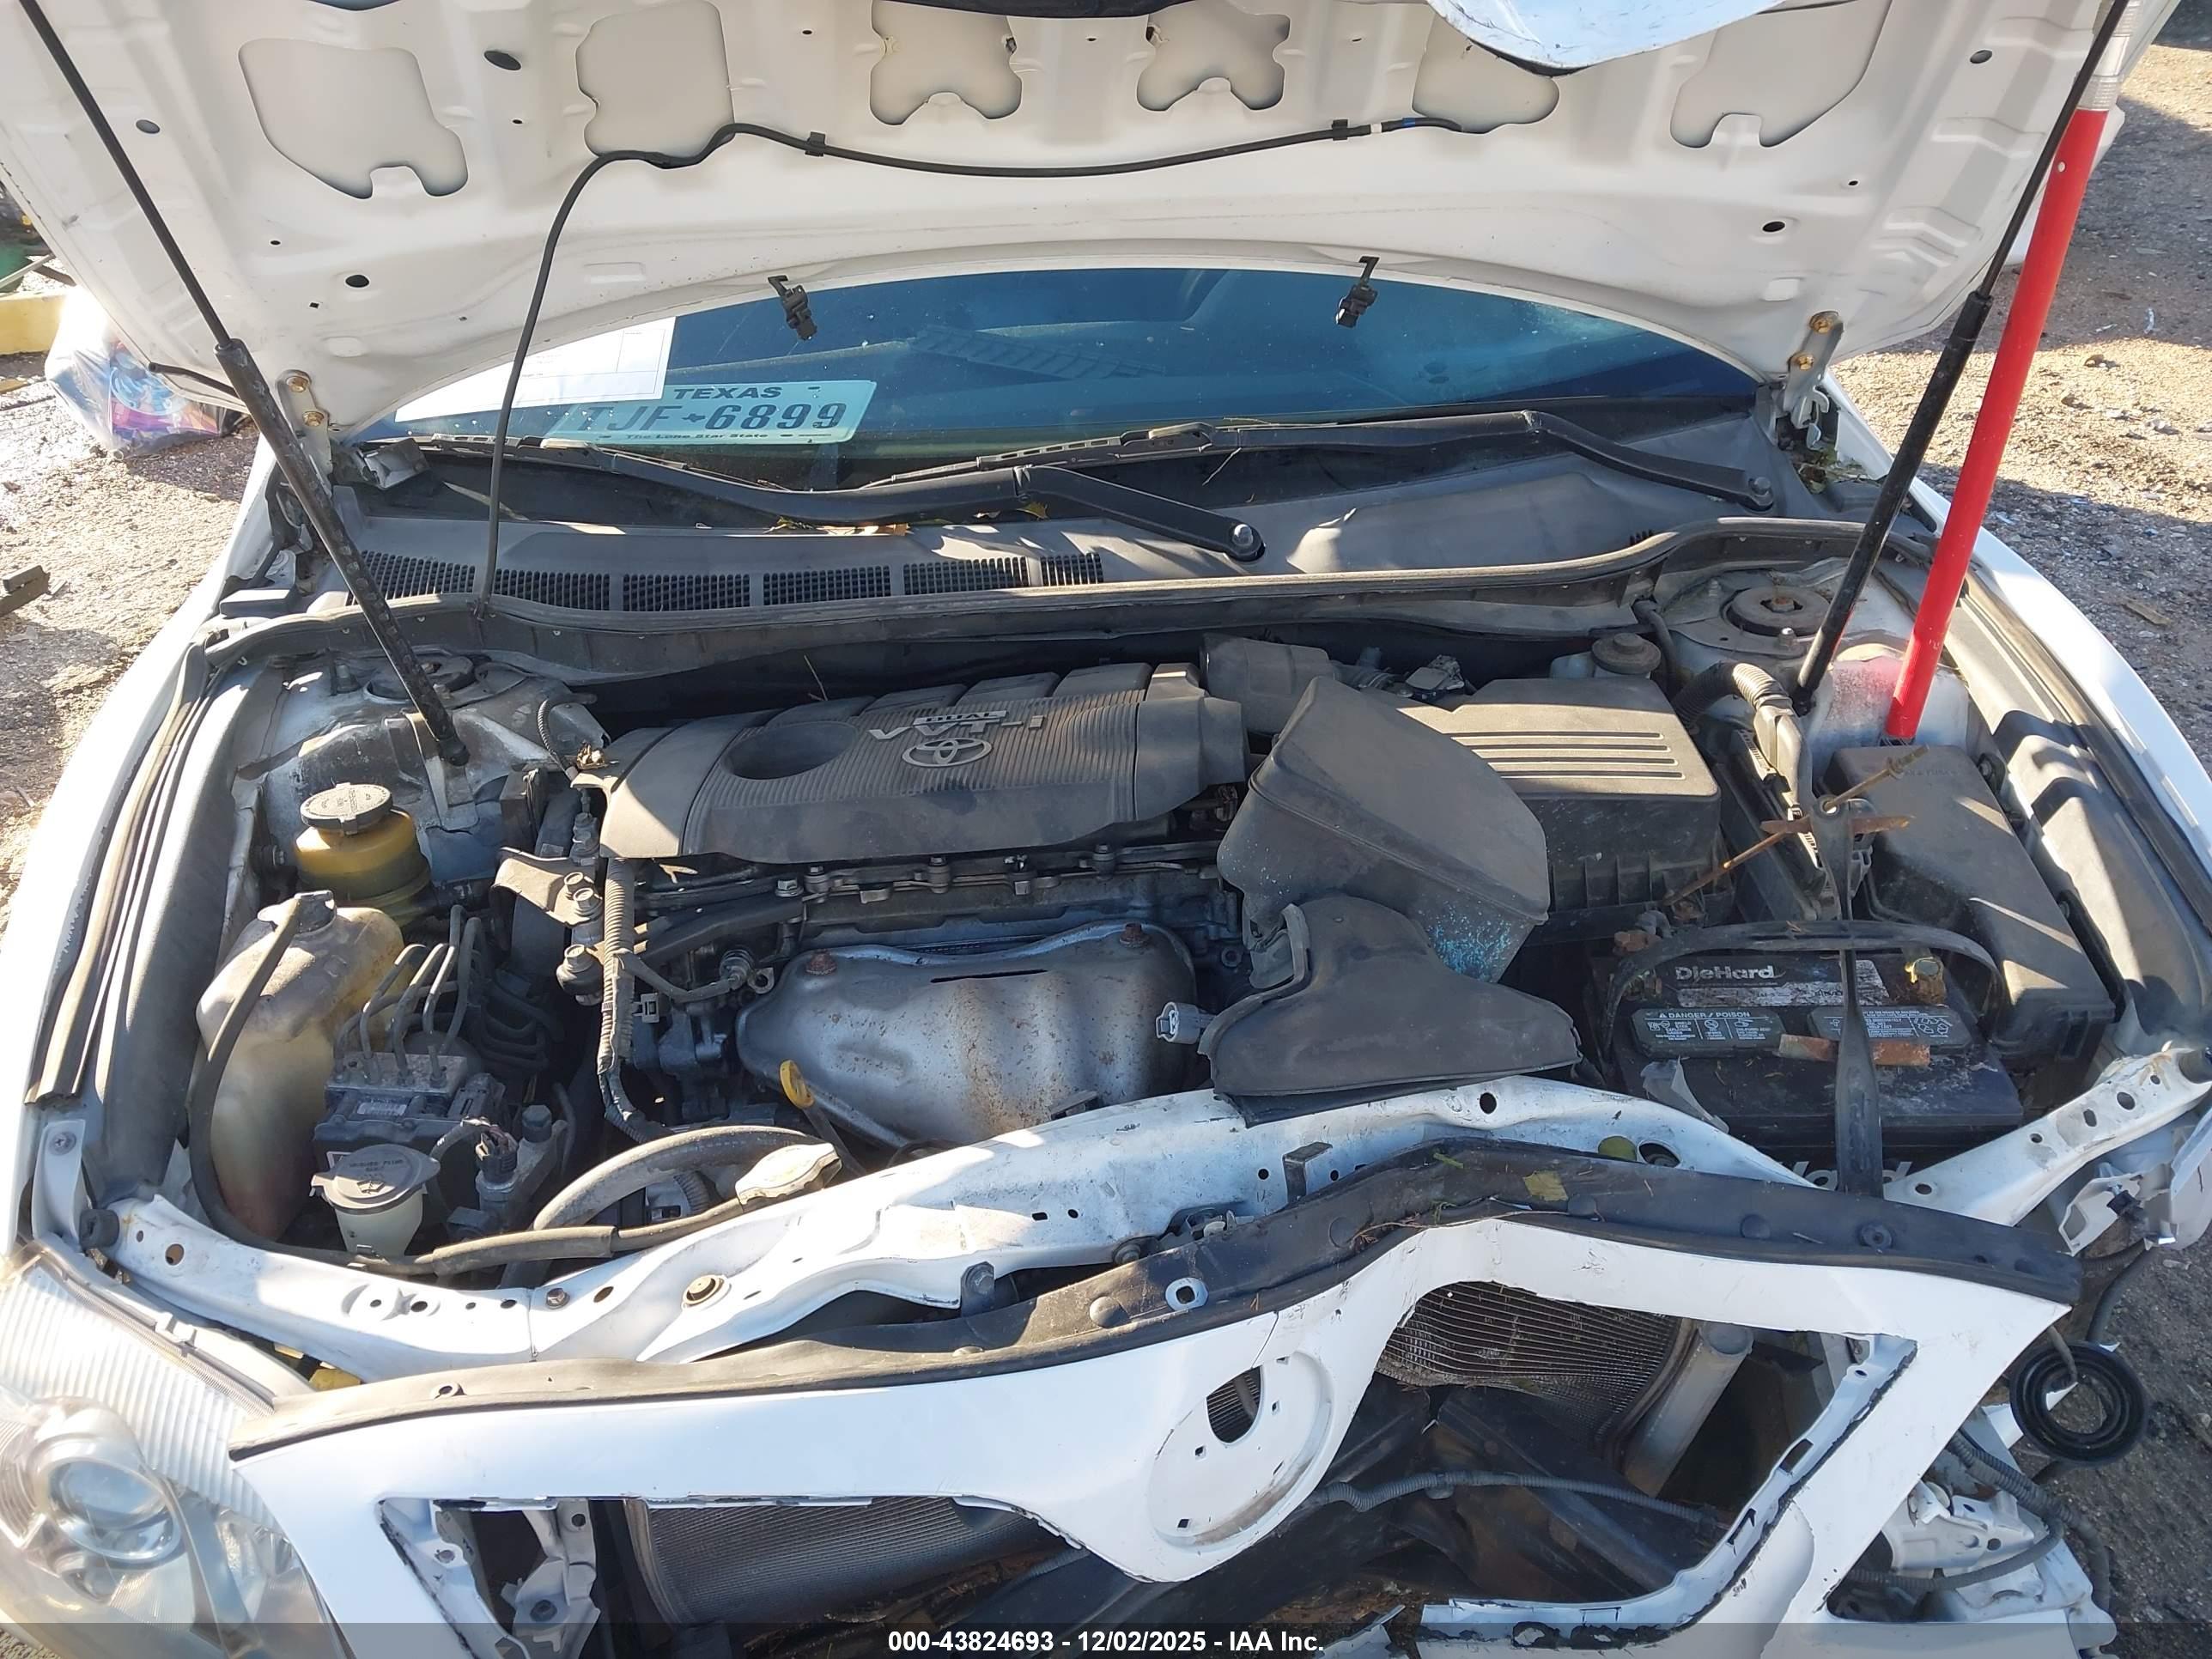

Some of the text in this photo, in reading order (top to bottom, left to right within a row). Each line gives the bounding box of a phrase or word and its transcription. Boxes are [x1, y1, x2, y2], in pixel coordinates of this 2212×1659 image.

[674, 386, 783, 399] TEXAS
[704, 403, 847, 430] 6899
[868, 714, 1047, 740] VVT-i
[1675, 965, 1775, 981] DieHard
